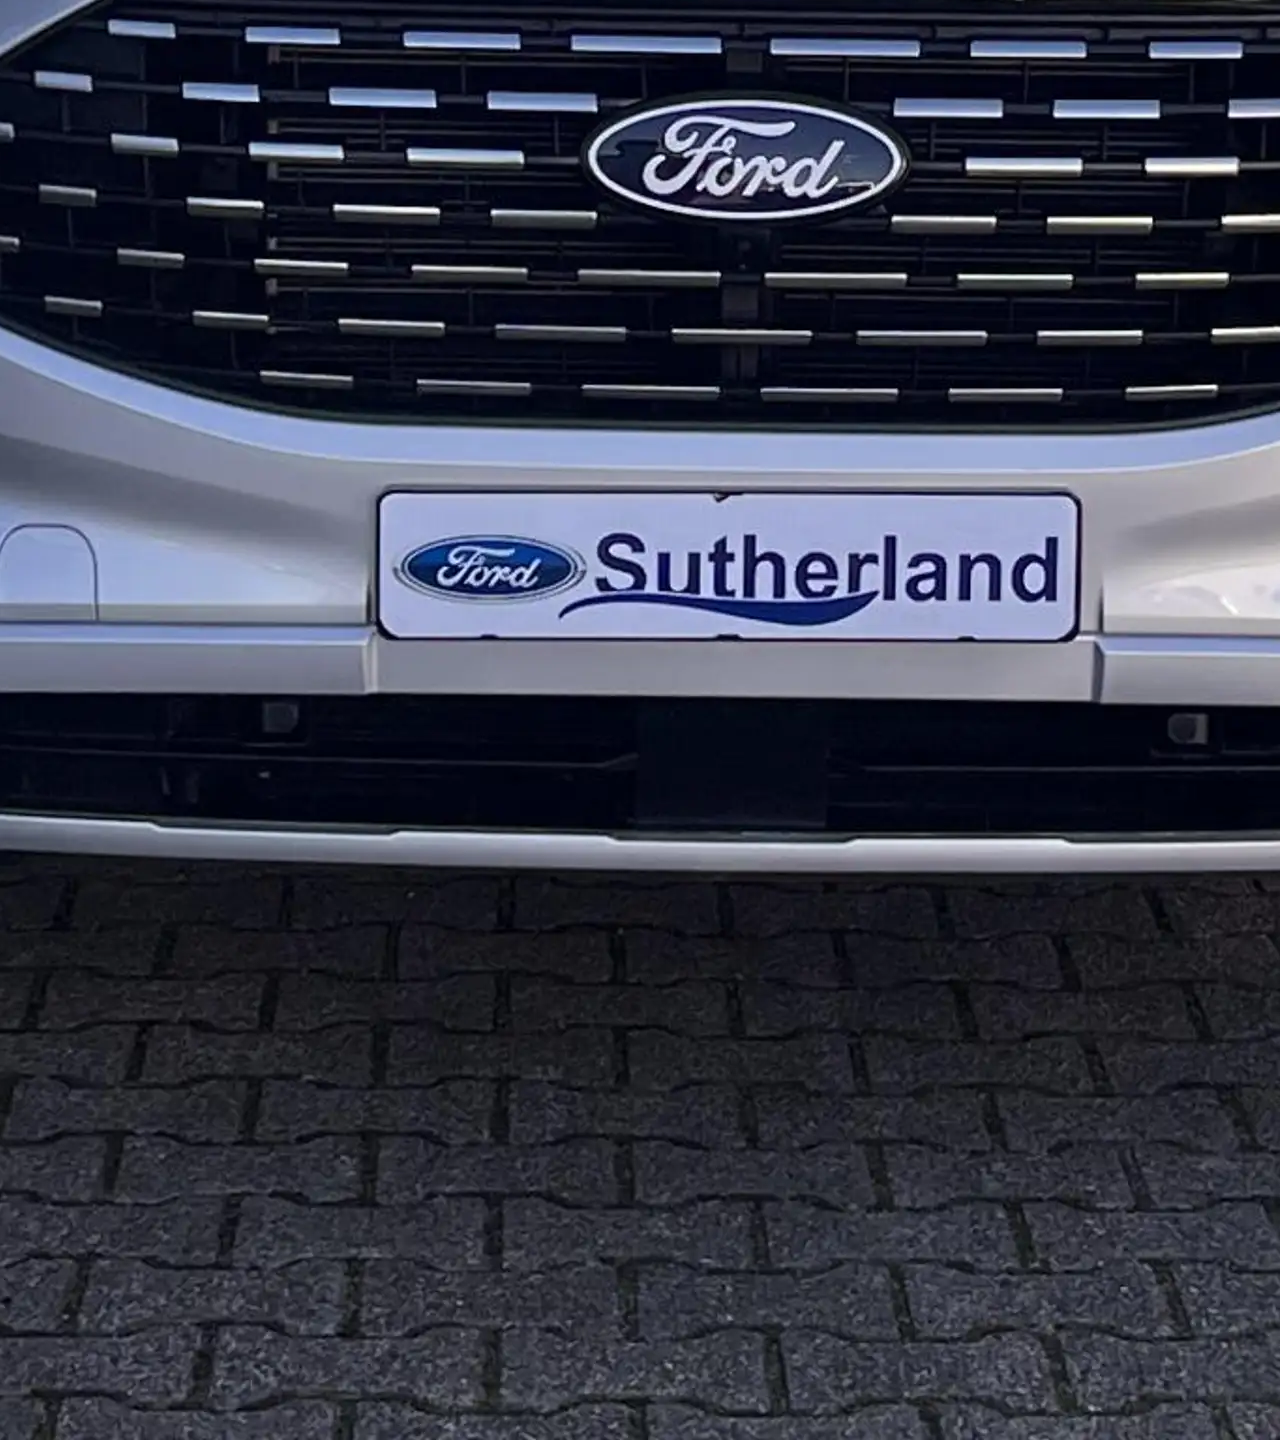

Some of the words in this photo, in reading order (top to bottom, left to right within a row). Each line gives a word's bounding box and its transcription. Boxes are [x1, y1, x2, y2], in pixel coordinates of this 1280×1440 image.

[642, 115, 845, 199] Ford
[437, 544, 540, 589] Ford
[594, 532, 1059, 603] Sutherland
